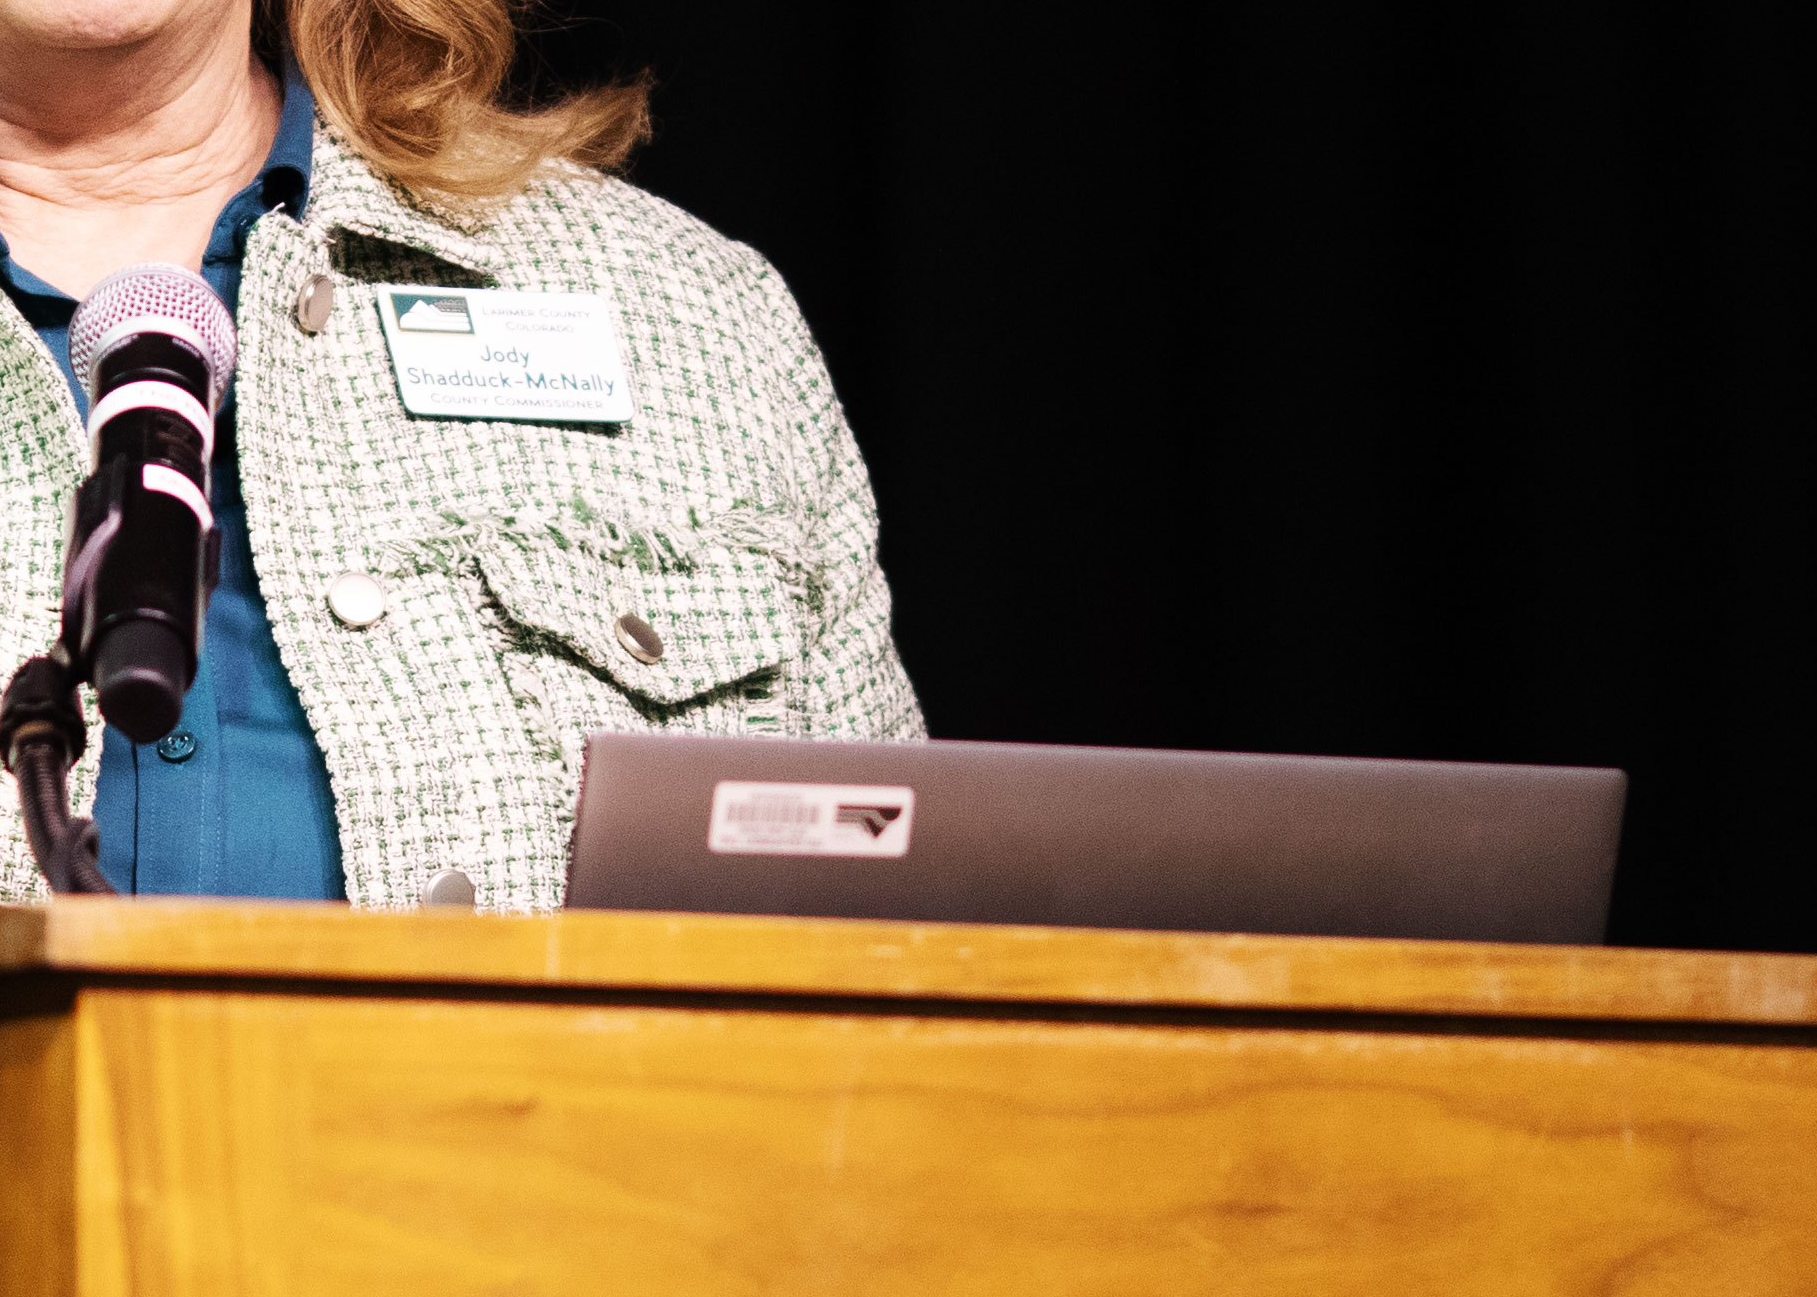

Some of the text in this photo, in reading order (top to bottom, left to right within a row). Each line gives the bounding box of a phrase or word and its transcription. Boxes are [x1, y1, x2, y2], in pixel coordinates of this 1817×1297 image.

[539, 307, 591, 319] COUNTY
[480, 345, 530, 368] Jody
[406, 367, 615, 396] Shadduck-McNally
[430, 392, 604, 410] COUNTY COMMISSIONER
